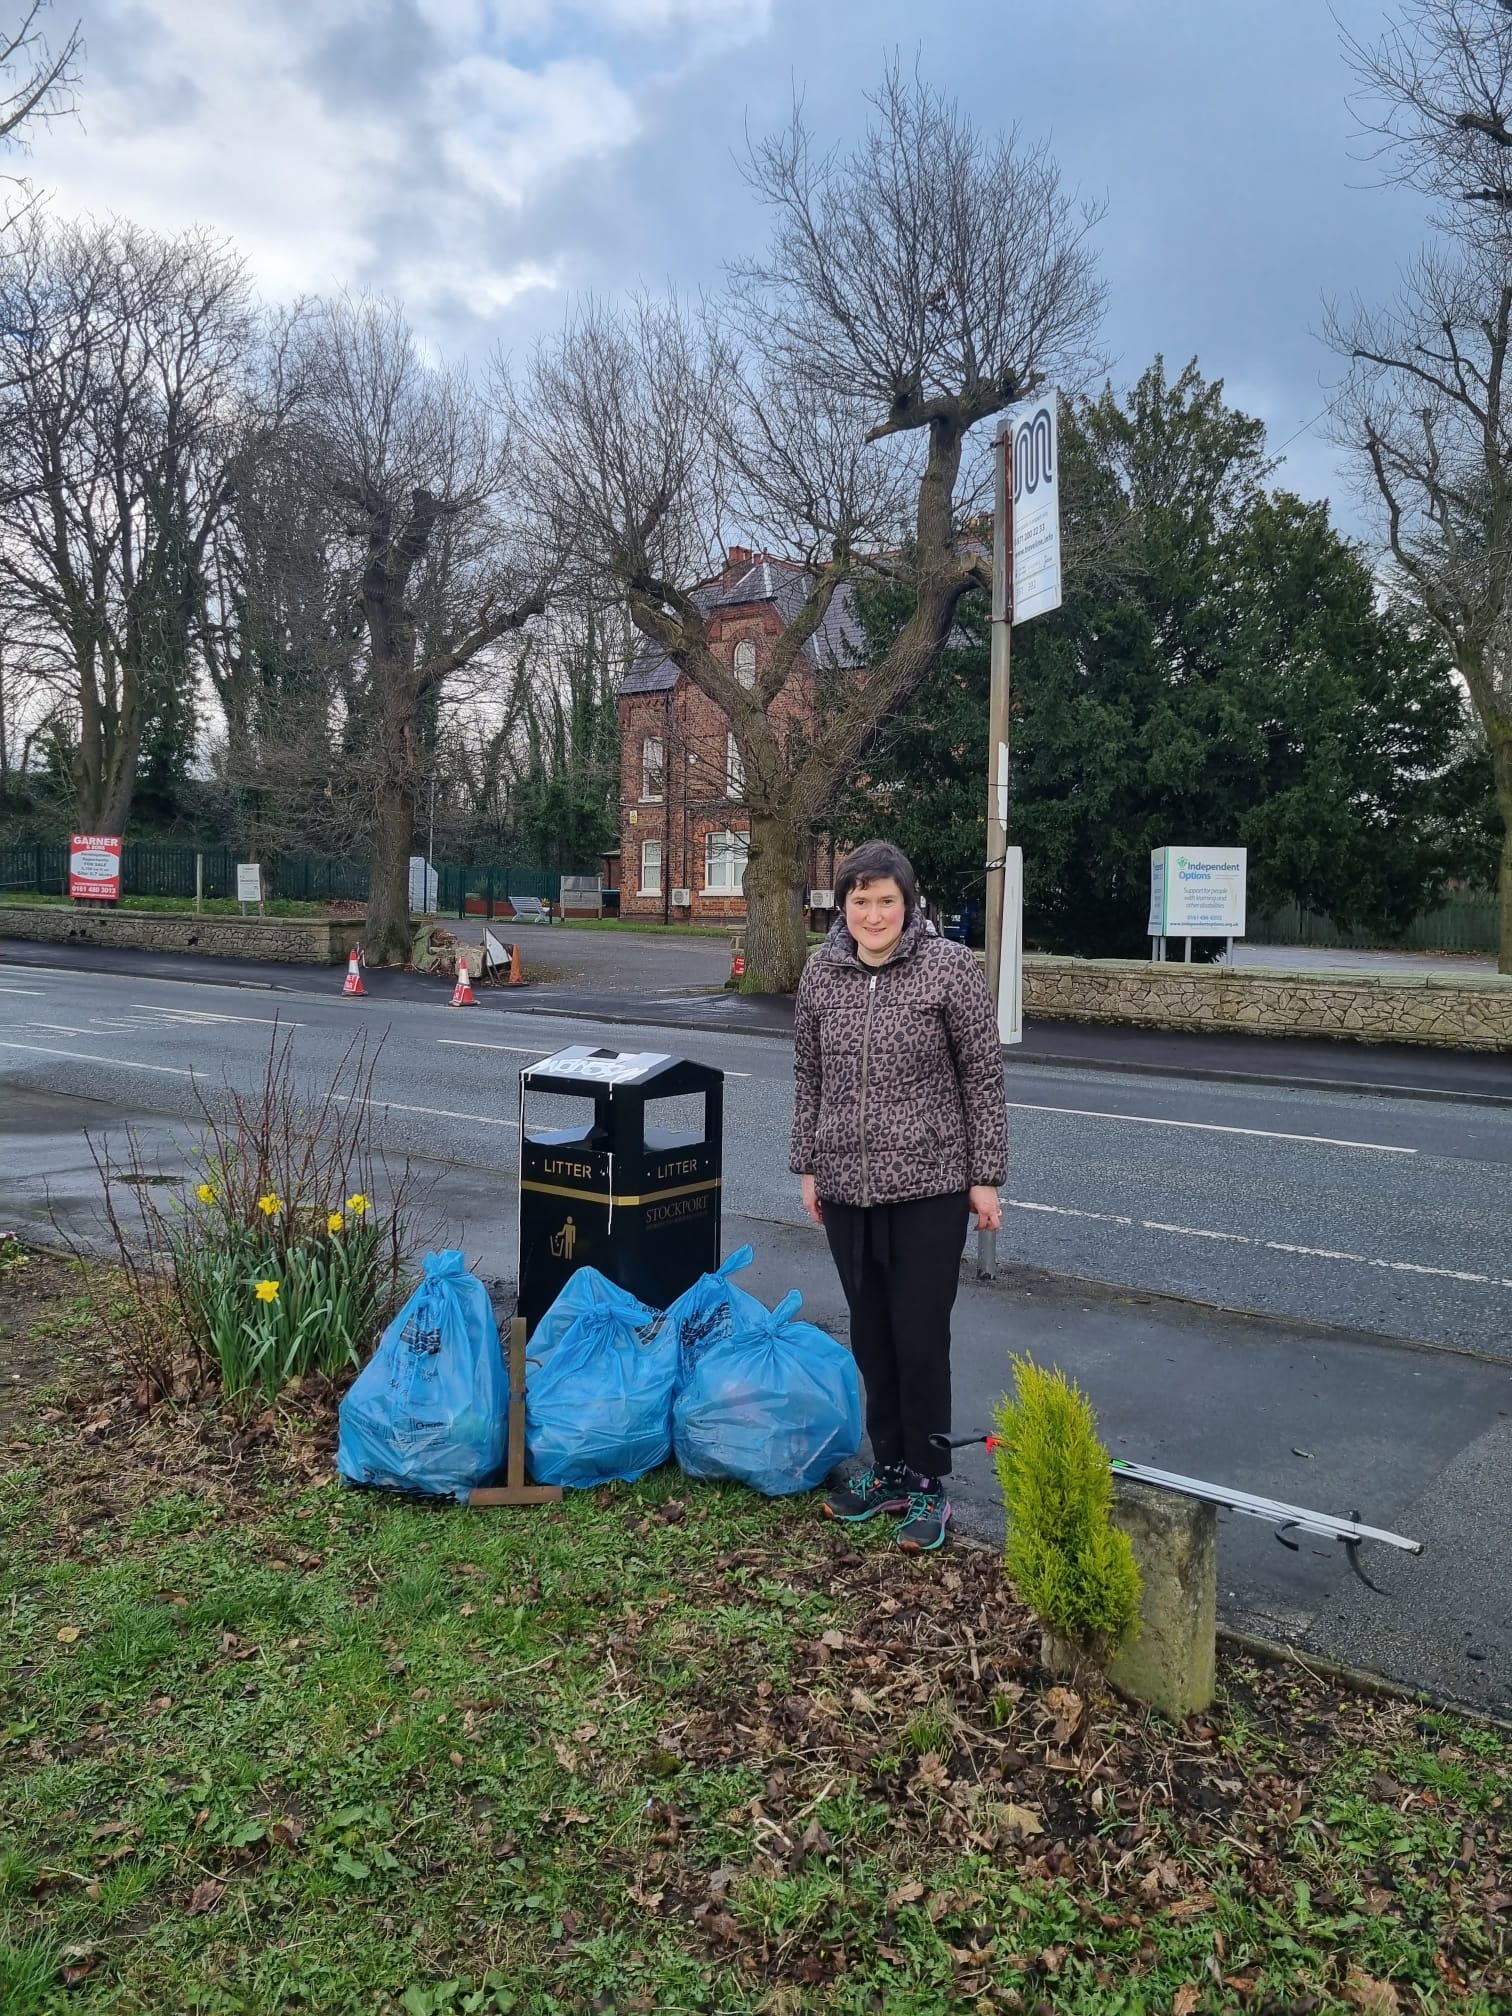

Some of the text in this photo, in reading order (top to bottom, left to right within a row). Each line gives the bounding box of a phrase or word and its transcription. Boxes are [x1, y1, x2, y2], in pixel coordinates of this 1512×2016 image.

[73, 836, 118, 847] GARNER
[1187, 861, 1240, 872] Independent
[1179, 871, 1211, 881] Options
[544, 1159, 592, 1179] LITTER
[657, 1159, 697, 1179] LITTER
[646, 1194, 709, 1223] STOCKPORT
